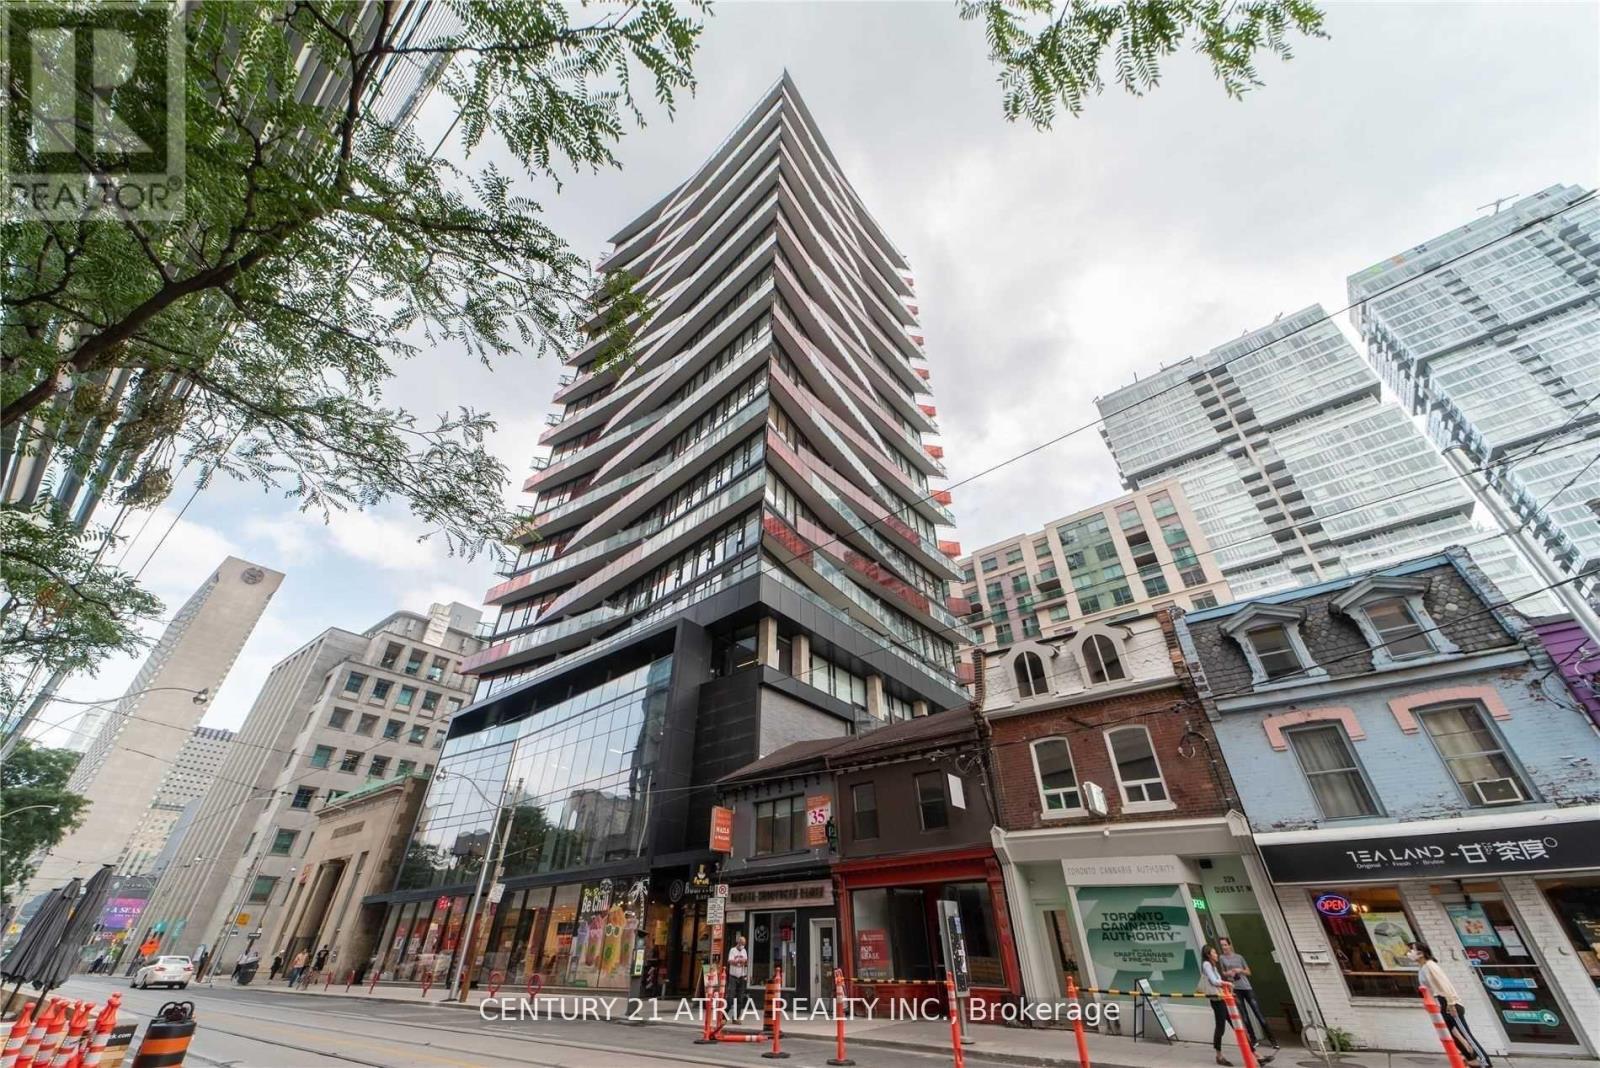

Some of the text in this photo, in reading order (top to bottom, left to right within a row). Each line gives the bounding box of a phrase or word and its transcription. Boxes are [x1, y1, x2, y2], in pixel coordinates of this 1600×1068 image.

[1346, 845, 1445, 862] TEA LAND
[1319, 900, 1346, 910] OPEN
[1101, 912, 1164, 921] TORONTO
[1101, 922, 1171, 931] CANNABIS
